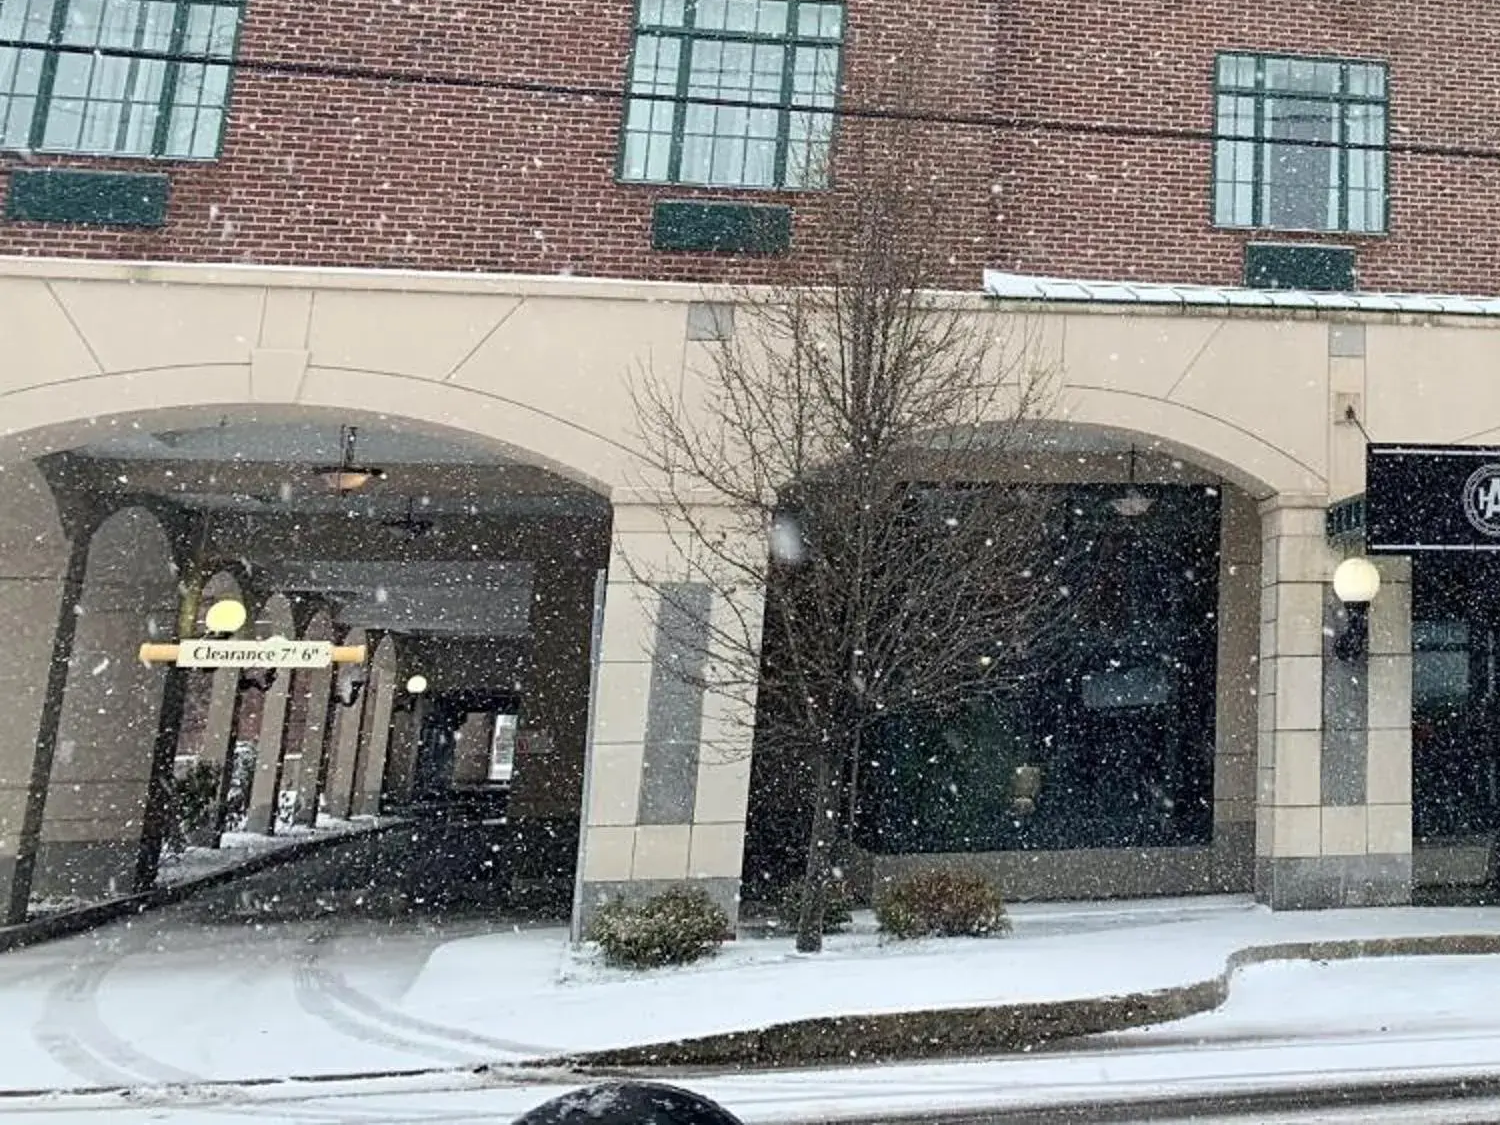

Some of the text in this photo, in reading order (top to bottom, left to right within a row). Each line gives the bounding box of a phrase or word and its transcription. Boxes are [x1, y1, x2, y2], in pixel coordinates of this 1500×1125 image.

[193, 646, 319, 661] Clearance 7' 6"
